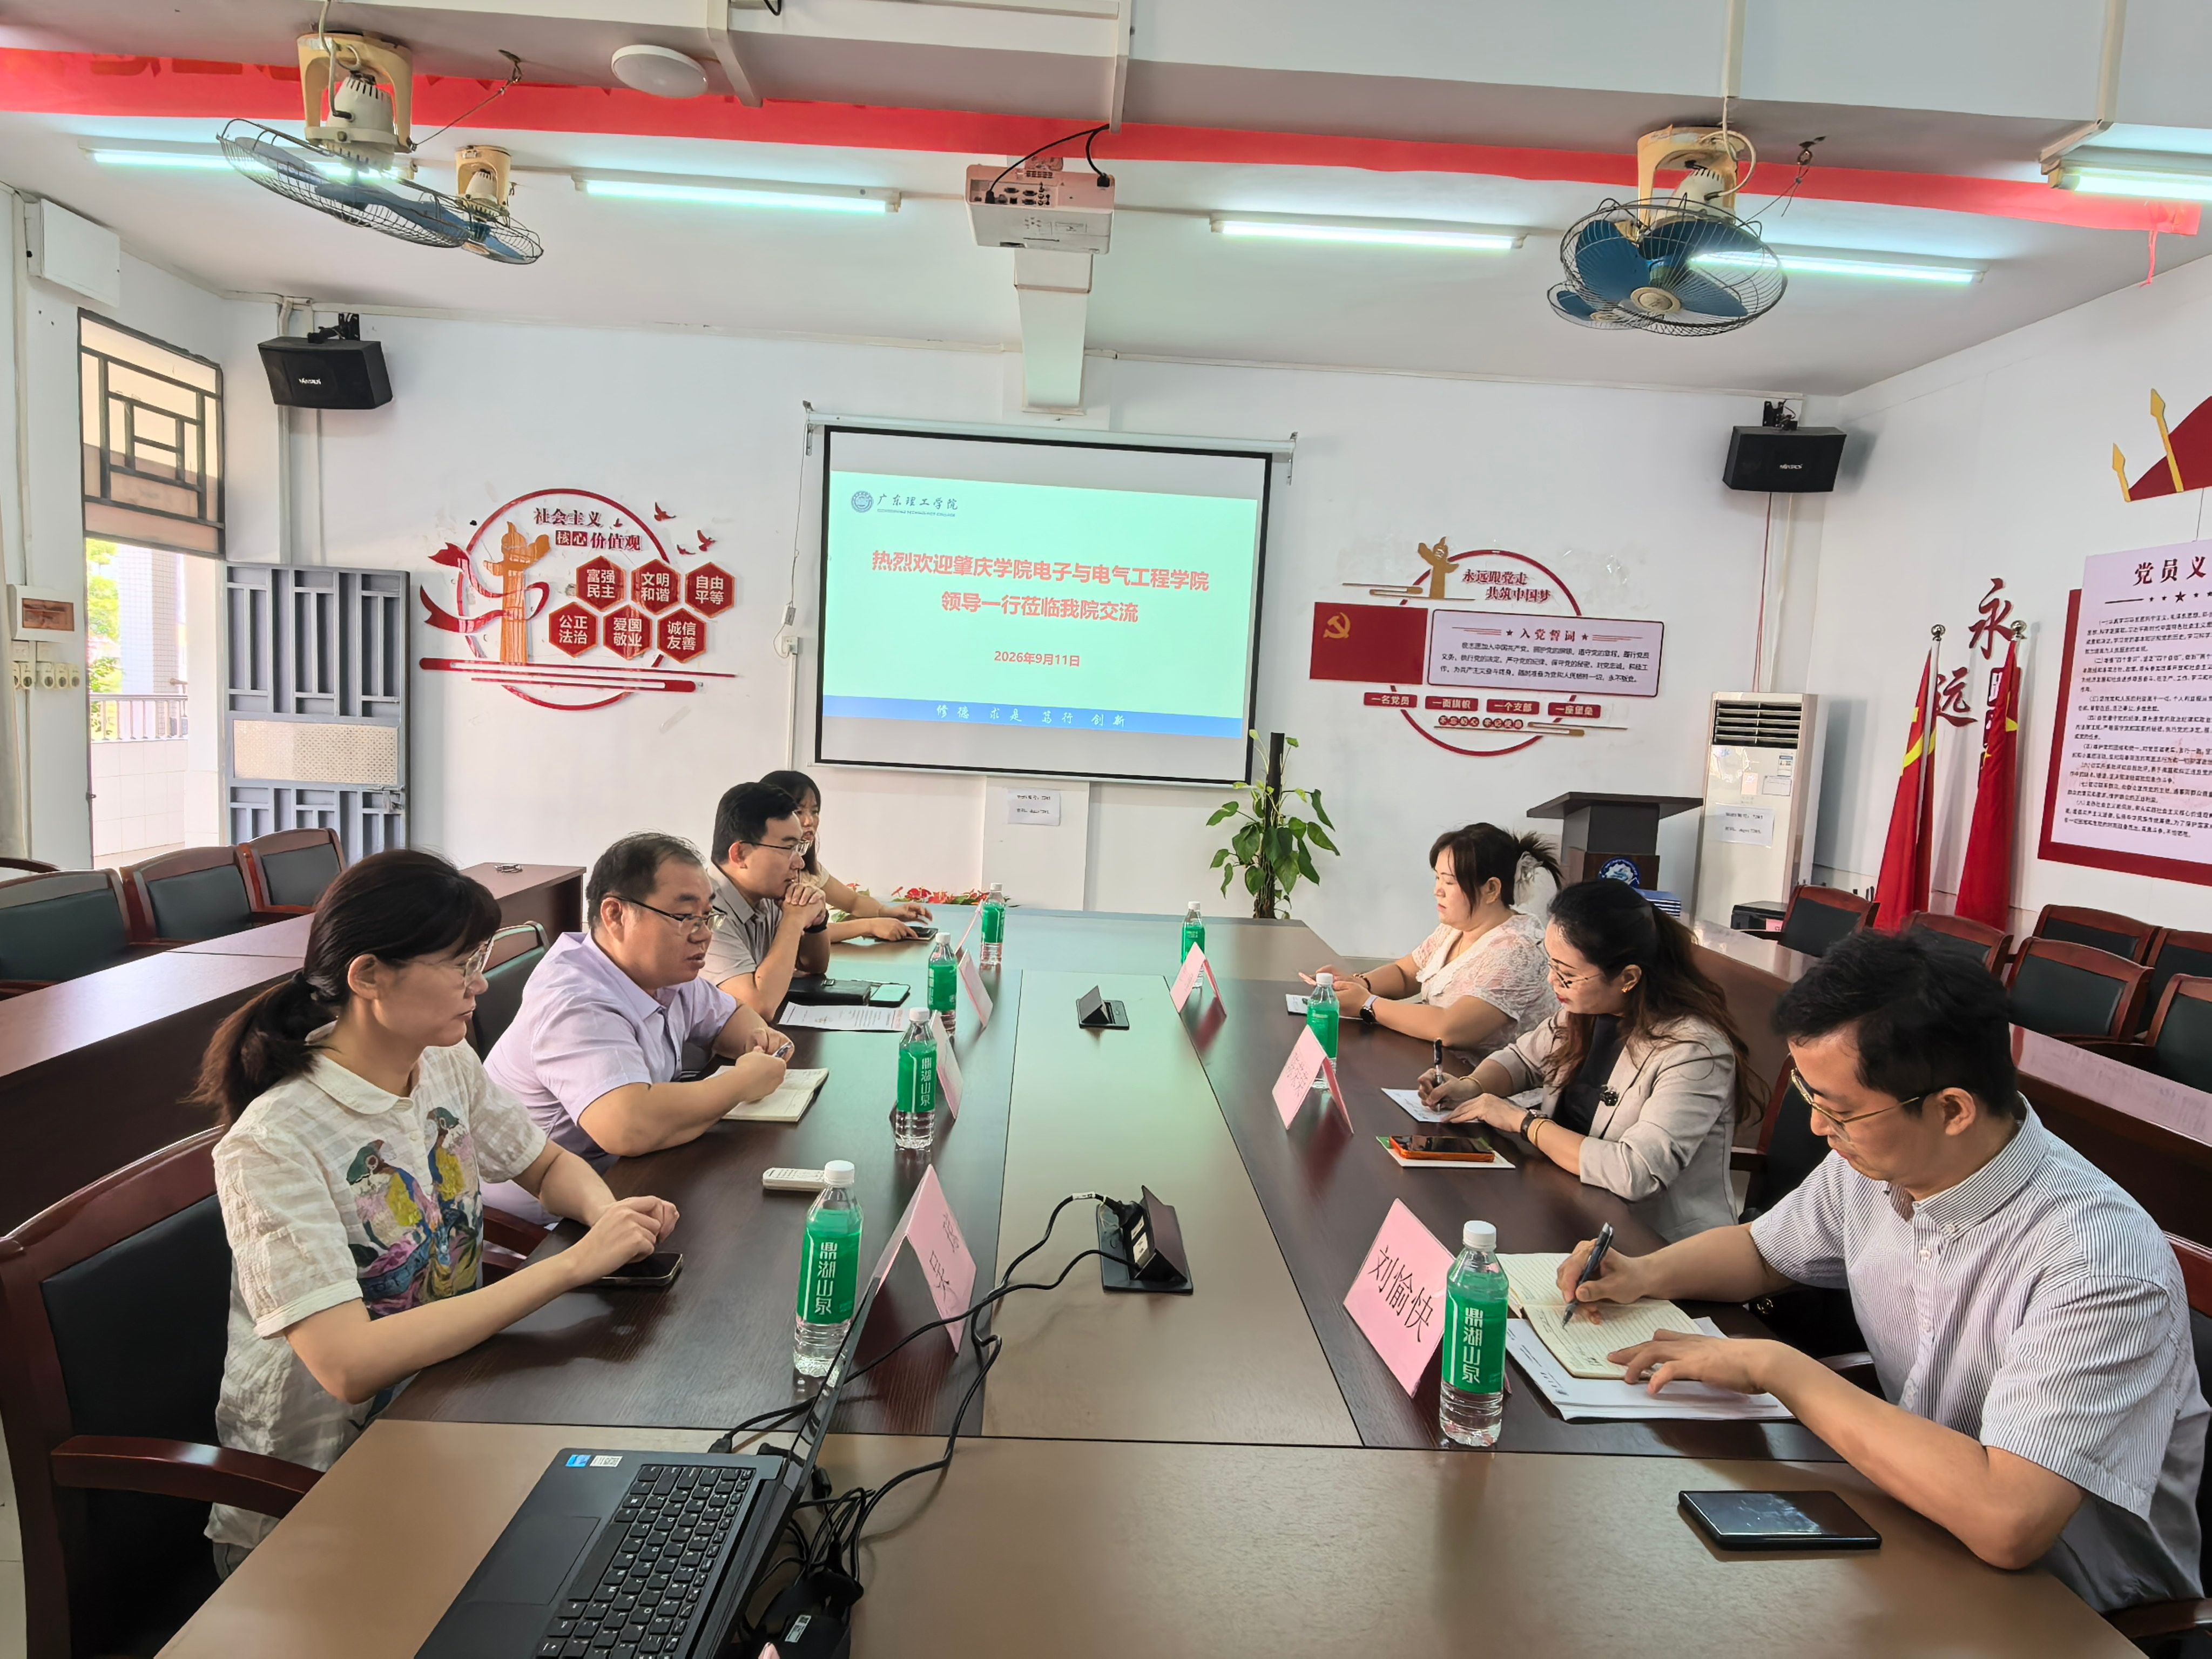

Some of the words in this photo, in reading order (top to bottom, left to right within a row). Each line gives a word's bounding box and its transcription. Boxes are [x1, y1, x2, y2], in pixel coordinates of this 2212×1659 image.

[877, 494, 958, 510] 广东理工学院
[534, 508, 601, 527] 社会主义
[556, 530, 641, 551] 核心价值观
[586, 569, 616, 585] 富强
[641, 572, 670, 586] 文明
[872, 550, 1210, 592] 热烈欢迎肇庆学院电子与电气工程学院
[1461, 569, 1528, 585] 永远跟党走
[2133, 556, 2207, 586] 党员义
[696, 575, 724, 590] 自由
[586, 585, 616, 599] 民主
[641, 588, 670, 602] 和谐
[696, 590, 724, 605] 平等
[1485, 587, 1552, 603] 共筑中国梦
[941, 591, 1139, 623] 领导一行莅临我院交流
[559, 615, 588, 630] 公正
[613, 618, 643, 632] 爱国
[1968, 578, 2012, 660] 永
[667, 621, 697, 636] 诚信
[559, 630, 588, 644] 法治
[613, 632, 643, 647] 敬业
[667, 636, 696, 650] 友善
[994, 650, 1080, 667] 2026年9月11日
[1371, 694, 1410, 705] 一名党员
[1494, 702, 1532, 712] 一个支部
[937, 704, 970, 720] 修德
[990, 707, 1023, 724] 求是
[1091, 713, 1127, 728] 创新
[814, 1242, 838, 1316] 鼎湖山泉
[1462, 1307, 1483, 1384] 鼎湖山泉
